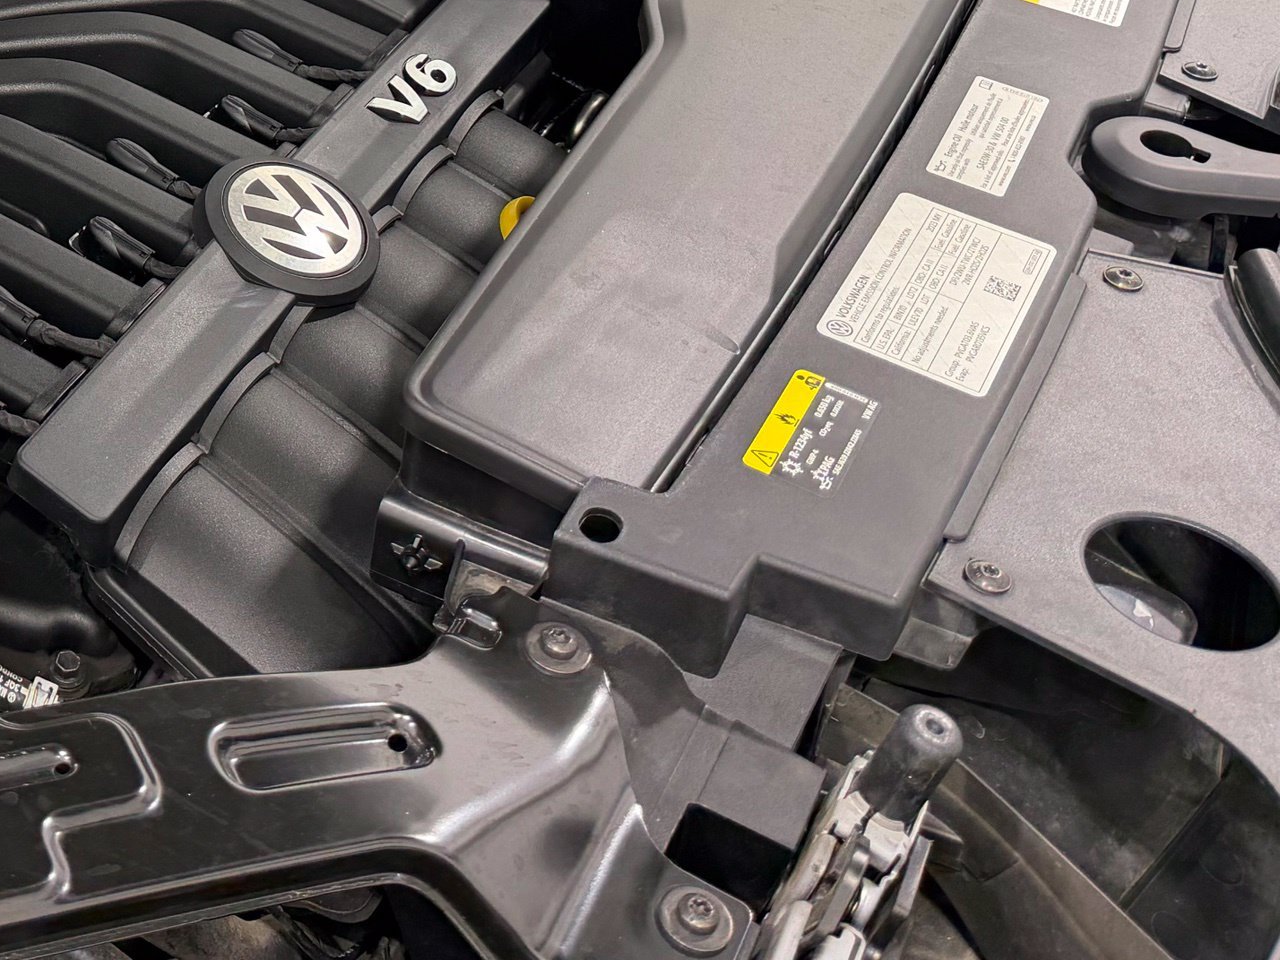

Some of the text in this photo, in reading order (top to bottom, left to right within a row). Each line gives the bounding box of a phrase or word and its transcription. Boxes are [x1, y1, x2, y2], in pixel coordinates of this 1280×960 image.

[366, 53, 457, 124] V6
[943, 140, 959, 158] Engine
[951, 133, 962, 142] Oil
[990, 131, 1002, 141] VW
[940, 218, 957, 238] Gasoline
[953, 223, 971, 243] Gasoline
[847, 227, 912, 323] VEHICLE EMISSION CONTROL INFORMATION
[834, 273, 870, 318] VOLKSWAGEN
[859, 318, 881, 343] Conforms
[916, 323, 939, 356] adjustments
[787, 427, 813, 459] R-1234yf
[818, 454, 835, 471] PAG
[5, 678, 20, 692] 3QF
